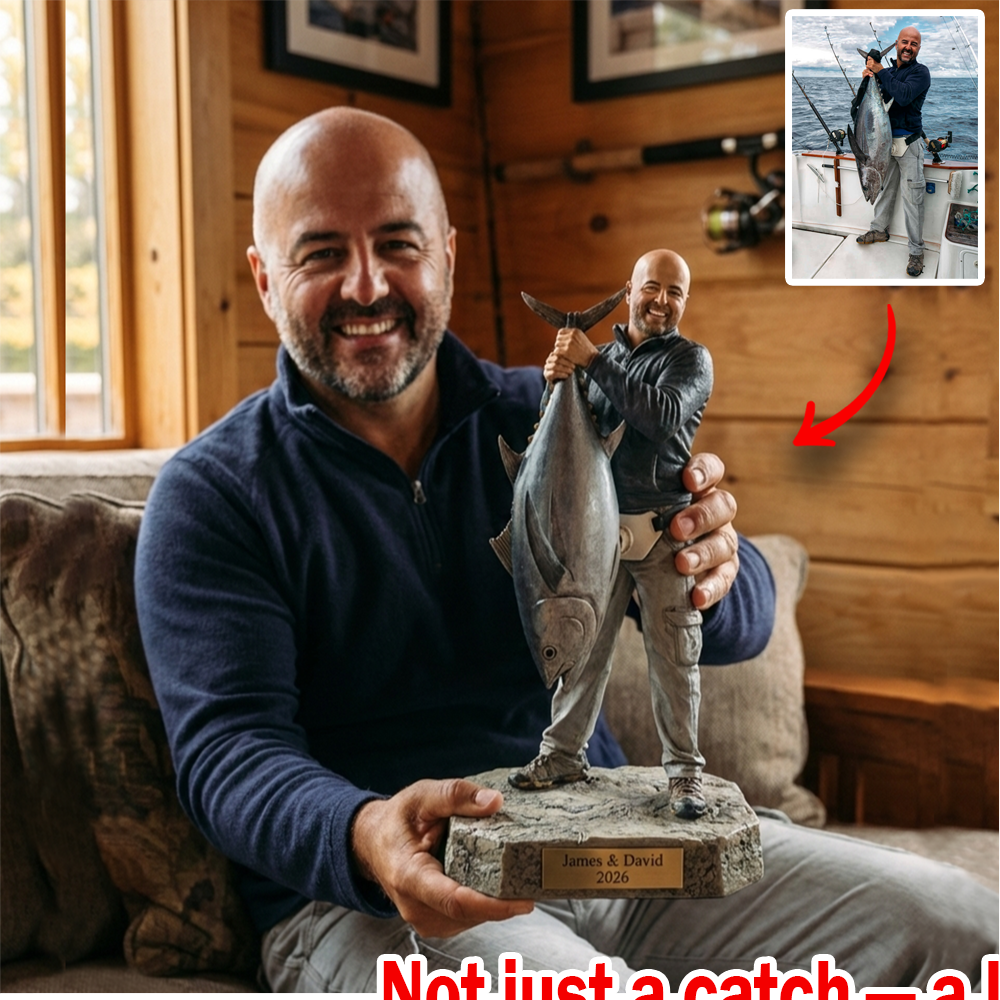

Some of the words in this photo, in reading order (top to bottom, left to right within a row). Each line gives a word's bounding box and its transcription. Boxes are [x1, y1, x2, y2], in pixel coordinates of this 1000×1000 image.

[562, 853, 603, 867] James
[607, 853, 619, 867] &
[624, 853, 663, 867] David
[596, 871, 629, 884] 2026
